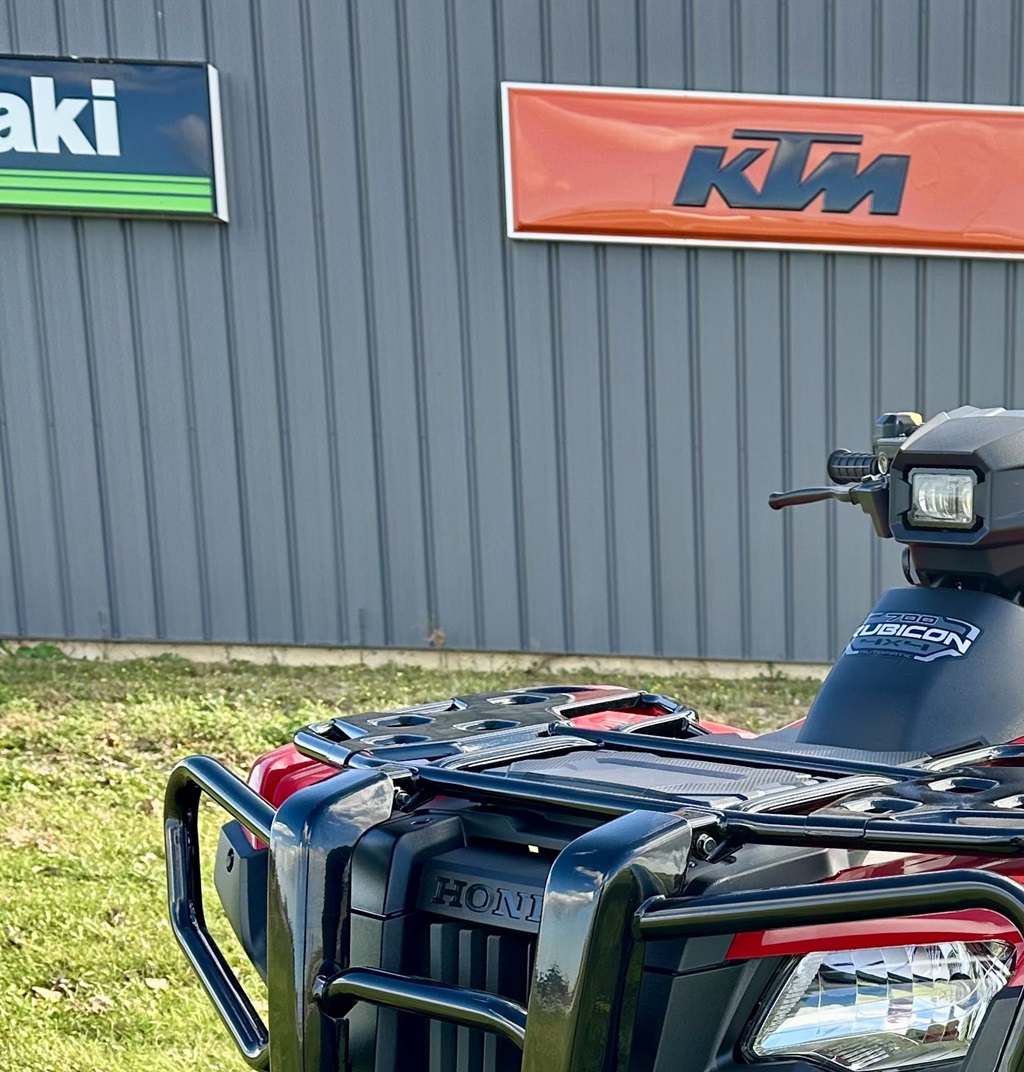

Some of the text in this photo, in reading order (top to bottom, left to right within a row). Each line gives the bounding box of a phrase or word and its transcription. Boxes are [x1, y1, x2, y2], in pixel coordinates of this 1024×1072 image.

[0, 76, 121, 157] aki
[673, 128, 911, 216] KTM
[885, 612, 938, 624] 700
[859, 649, 913, 659] AUTOMATIC
